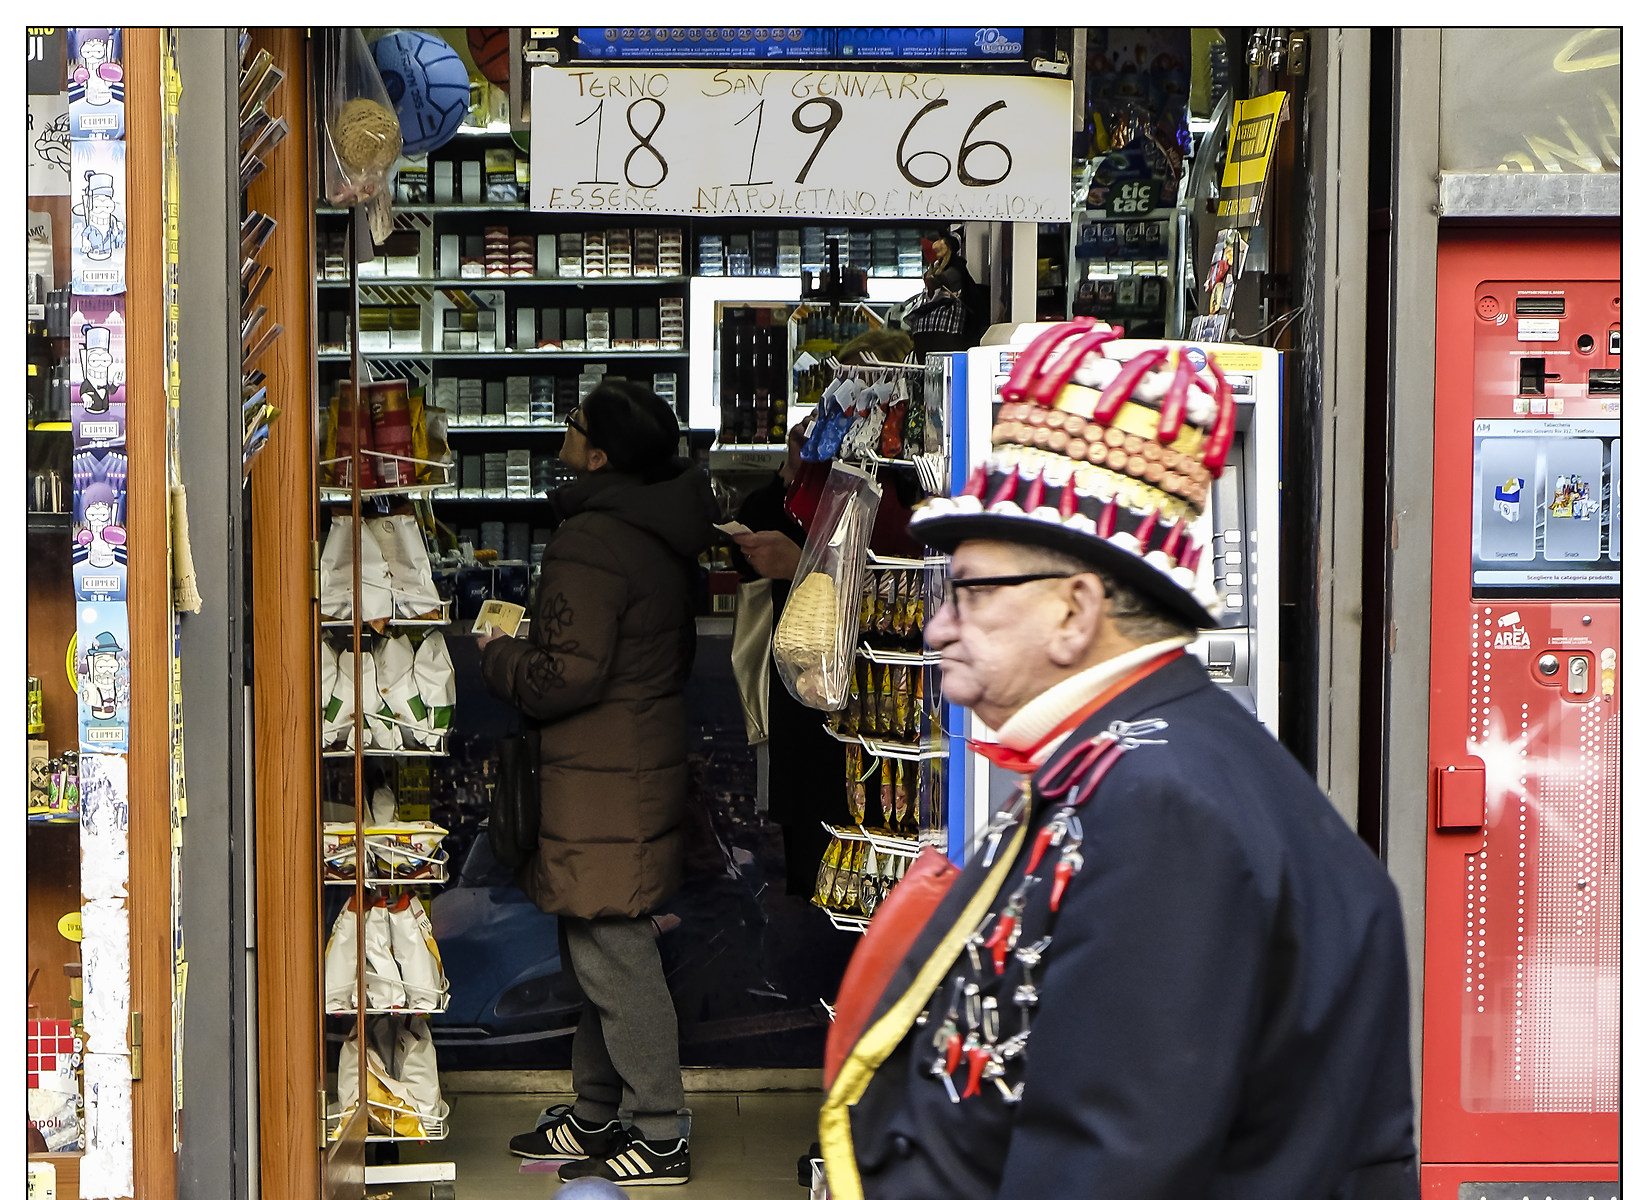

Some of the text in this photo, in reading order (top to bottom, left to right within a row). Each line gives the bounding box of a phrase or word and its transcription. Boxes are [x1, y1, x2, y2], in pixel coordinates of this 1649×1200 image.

[606, 29, 618, 39] 31
[623, 29, 635, 39] 22
[656, 29, 668, 39] 41
[672, 29, 685, 39] 26
[788, 29, 802, 39] 49
[974, 28, 1000, 47] 10
[568, 69, 945, 101] TERNO SAN GENNARO
[575, 96, 1013, 189] 18 19 66
[1121, 181, 1151, 199] tic
[549, 186, 658, 208] ESSERE
[691, 186, 877, 213] NAPOLETANO
[1113, 196, 1150, 213] tac
[1495, 551, 1519, 559] Sigarette
[1560, 574, 1588, 582] categoria
[1588, 574, 1614, 582] prodotto
[1493, 631, 1531, 646] AREA
